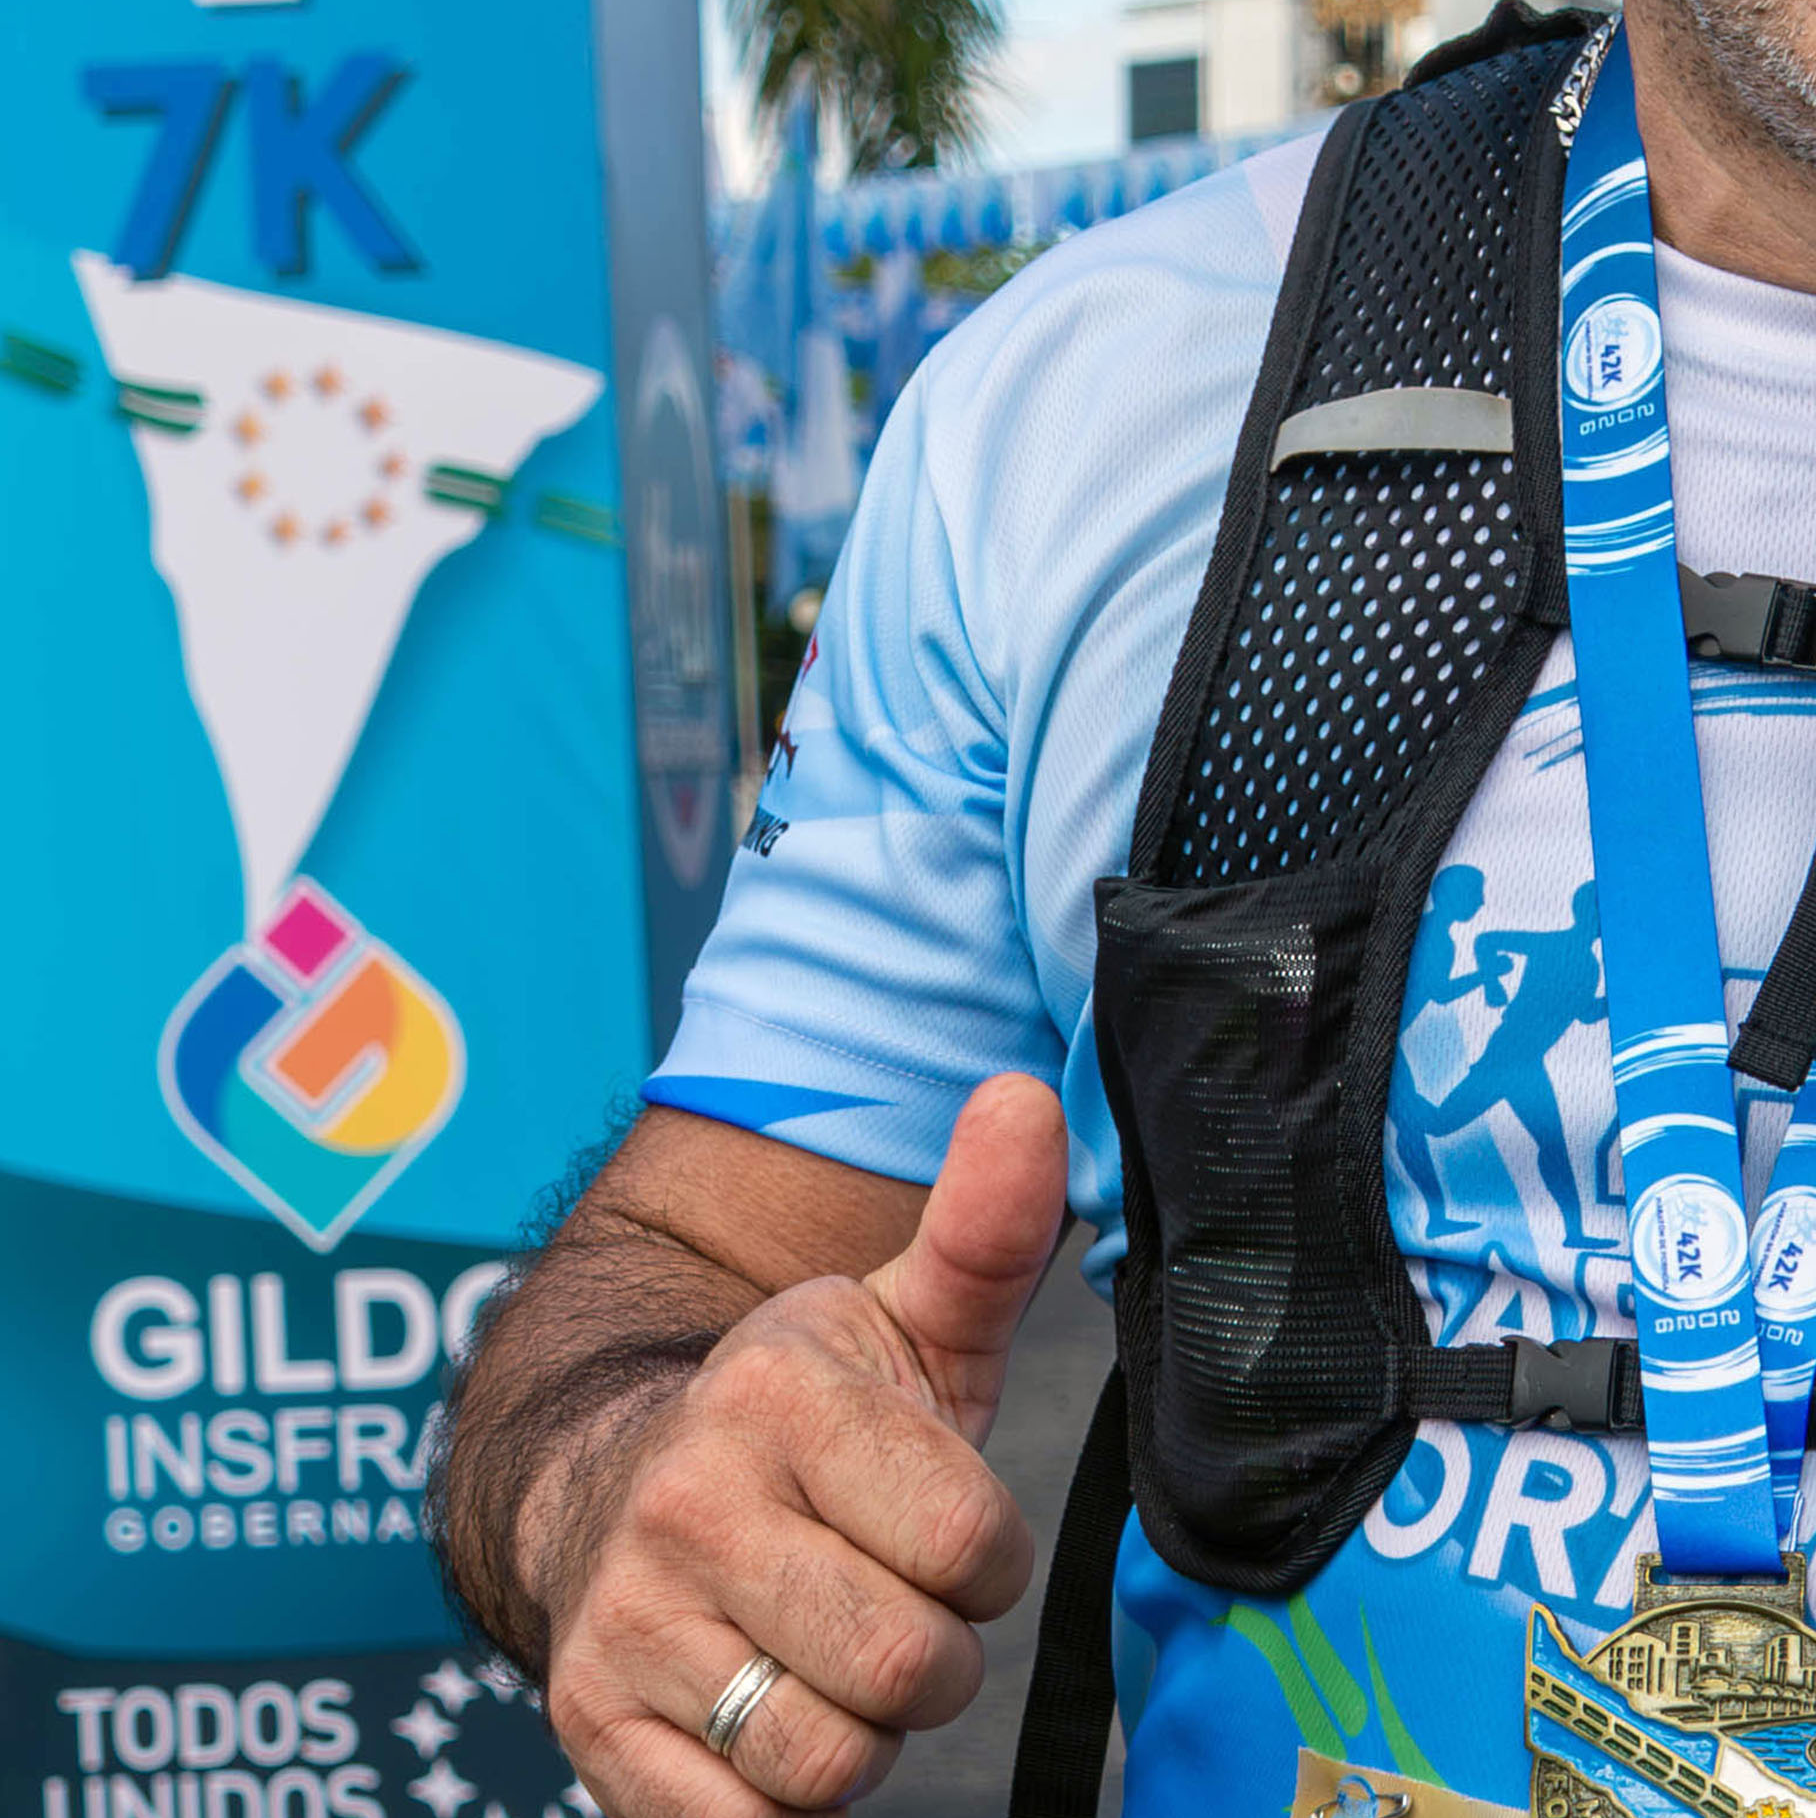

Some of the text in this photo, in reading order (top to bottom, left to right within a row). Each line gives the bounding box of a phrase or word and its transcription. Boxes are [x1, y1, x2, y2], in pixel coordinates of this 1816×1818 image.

[80, 49, 422, 281] 7K
[1600, 344, 1622, 389] 42K
[1676, 1231, 1703, 1281] 42K
[1768, 1241, 1804, 1292] 42K
[57, 1678, 360, 1773] TODOS
